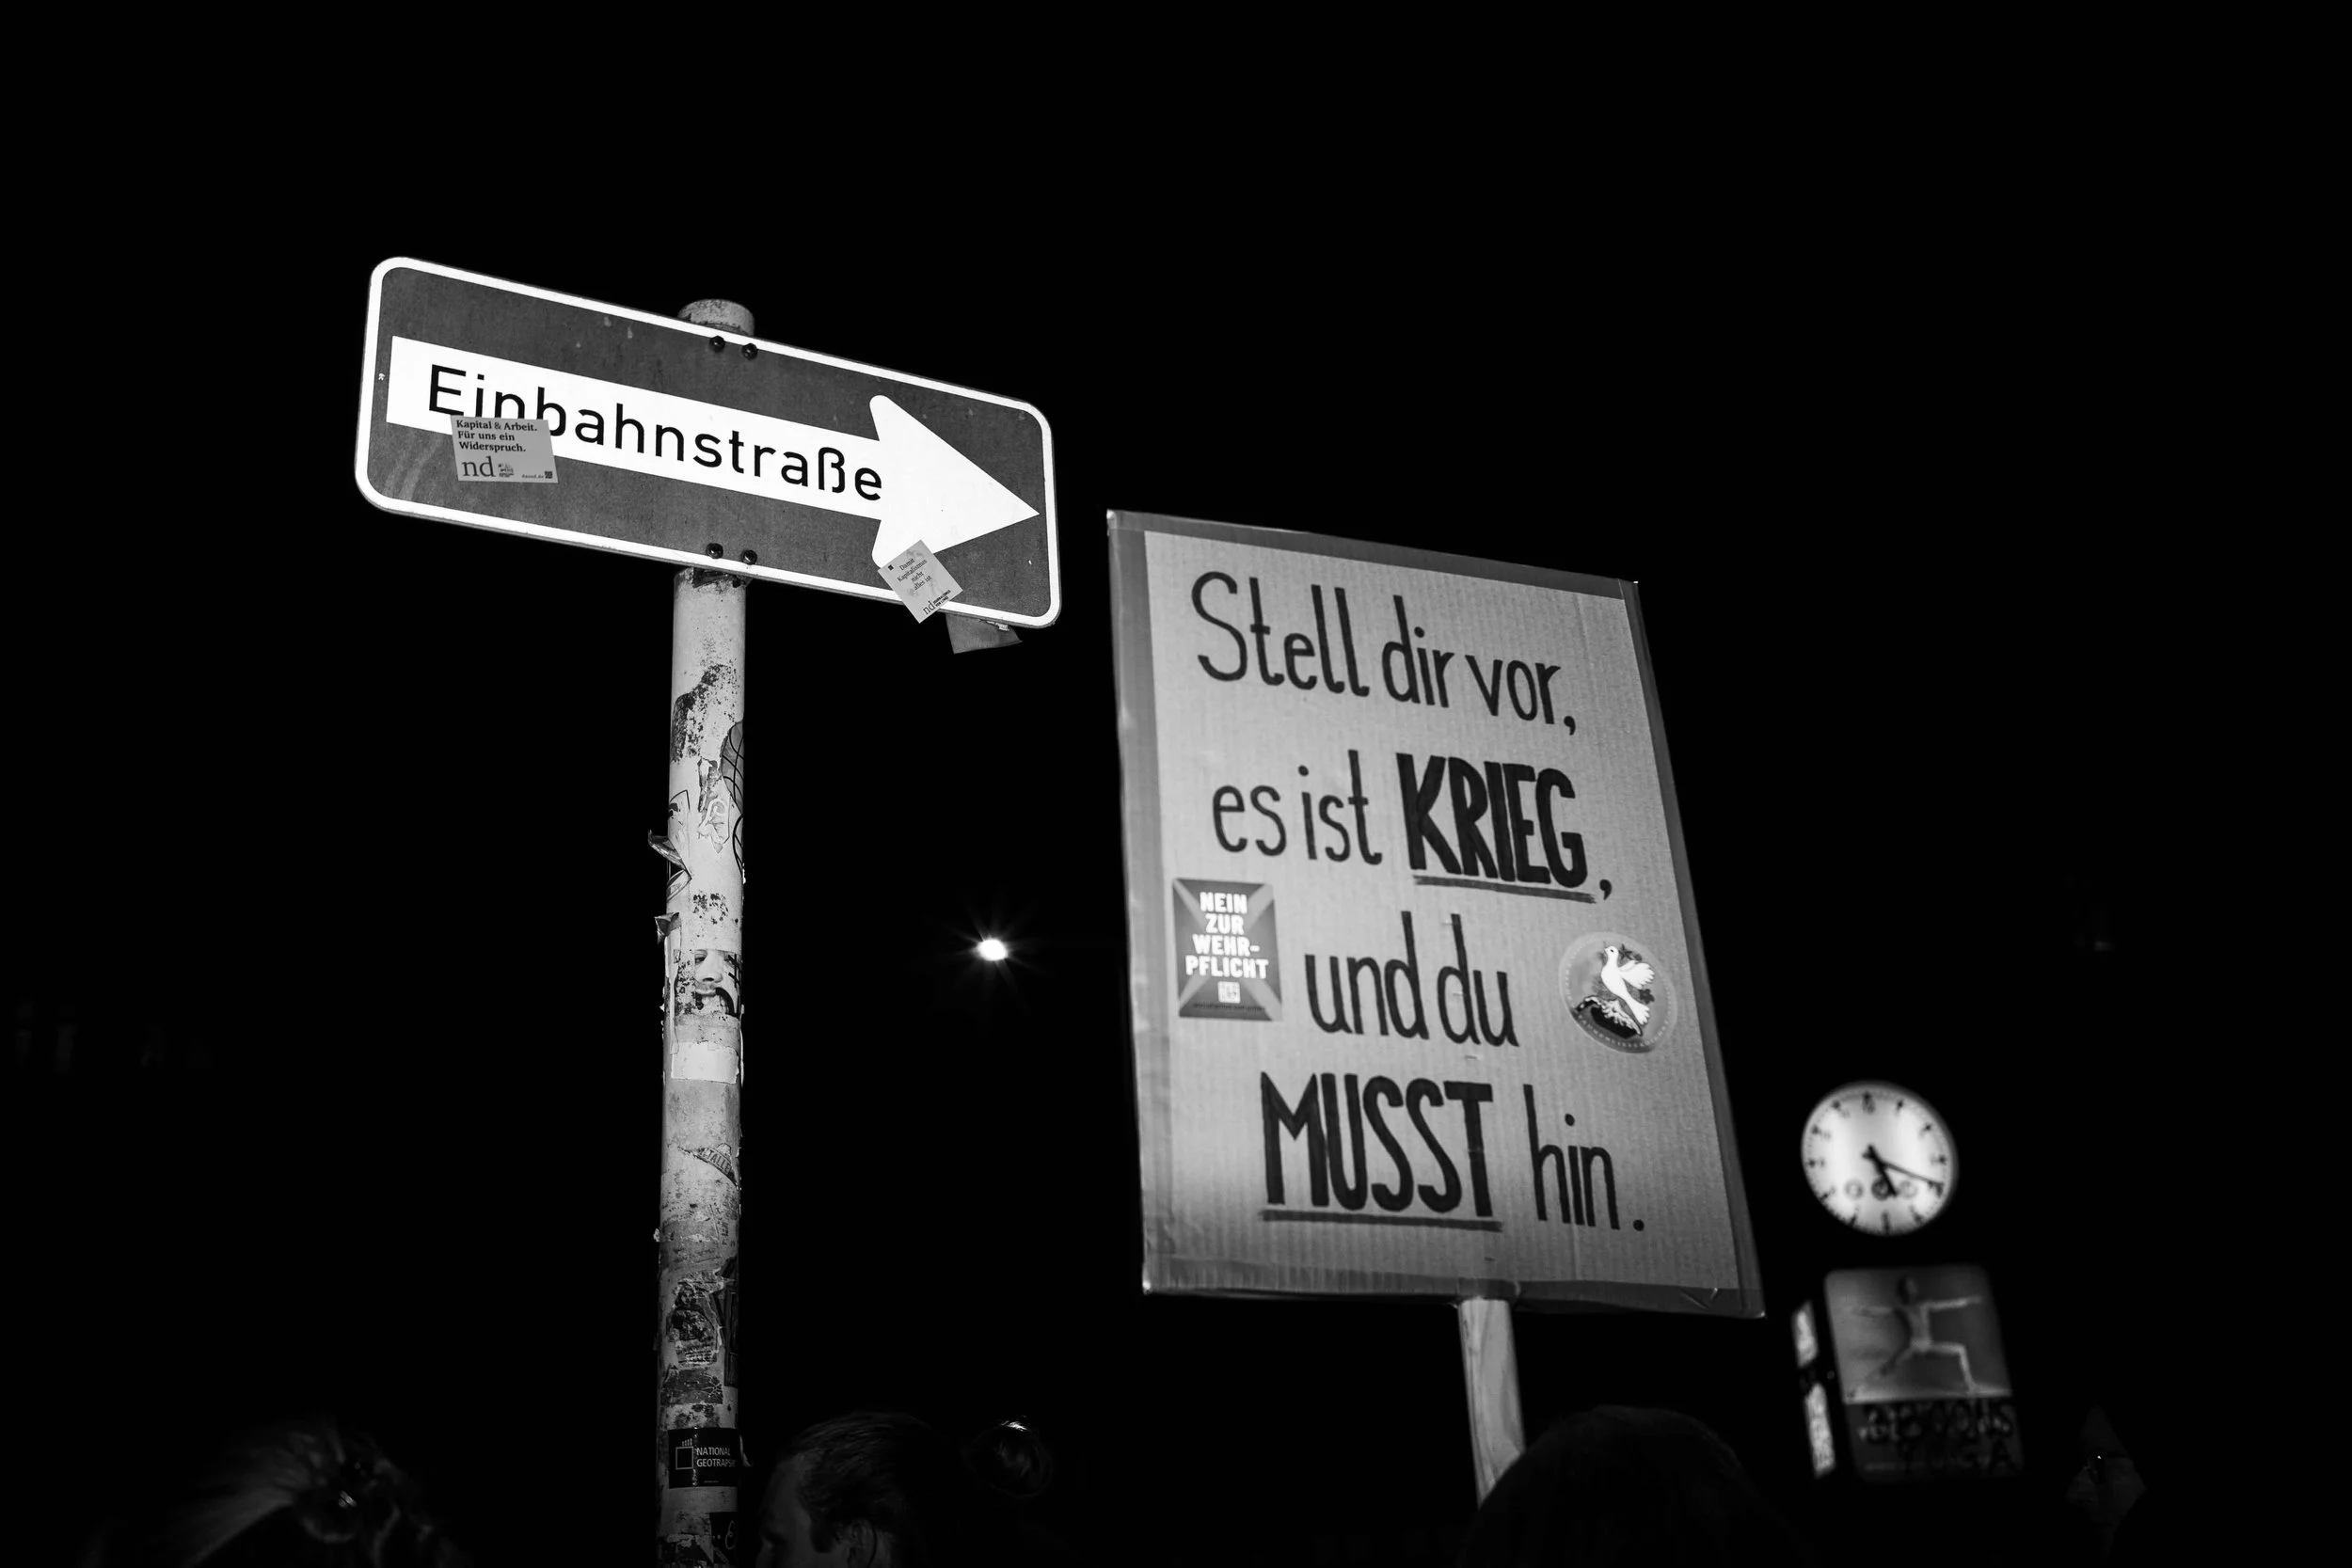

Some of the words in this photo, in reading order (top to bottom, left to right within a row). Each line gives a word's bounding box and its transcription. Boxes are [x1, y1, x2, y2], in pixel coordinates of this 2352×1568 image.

[429, 364, 882, 501] Einbahnstraße
[456, 420, 492, 431] Kapital
[494, 421, 501, 430] &
[503, 422, 537, 432] Arbeit.
[458, 430, 475, 439] Für
[500, 433, 516, 441] ein
[459, 441, 526, 452] Widerspruch.
[461, 455, 496, 478] nd
[897, 560, 927, 582] Kapitalismus
[899, 558, 915, 570] Damit
[911, 571, 924, 582] nicht
[914, 578, 926, 591] alles
[922, 600, 936, 614] nd
[1191, 571, 1370, 697] Stell
[1381, 594, 1454, 708] dir
[1465, 655, 1576, 736] vor,
[1213, 784, 1287, 857] es
[1298, 750, 1382, 865] ist
[1396, 752, 1612, 900] KRIEG,
[1200, 892, 1248, 914] NEIN
[1205, 912, 1245, 935] ZUR
[1192, 933, 1261, 957] WEHR-
[1185, 955, 1269, 979] PFLICHT
[1304, 910, 1430, 1040] und
[1437, 913, 1520, 1047] du
[1261, 1070, 1494, 1217] MUSST
[1522, 1084, 1645, 1231] hin.
[695, 1447, 731, 1456] NATIONAL
